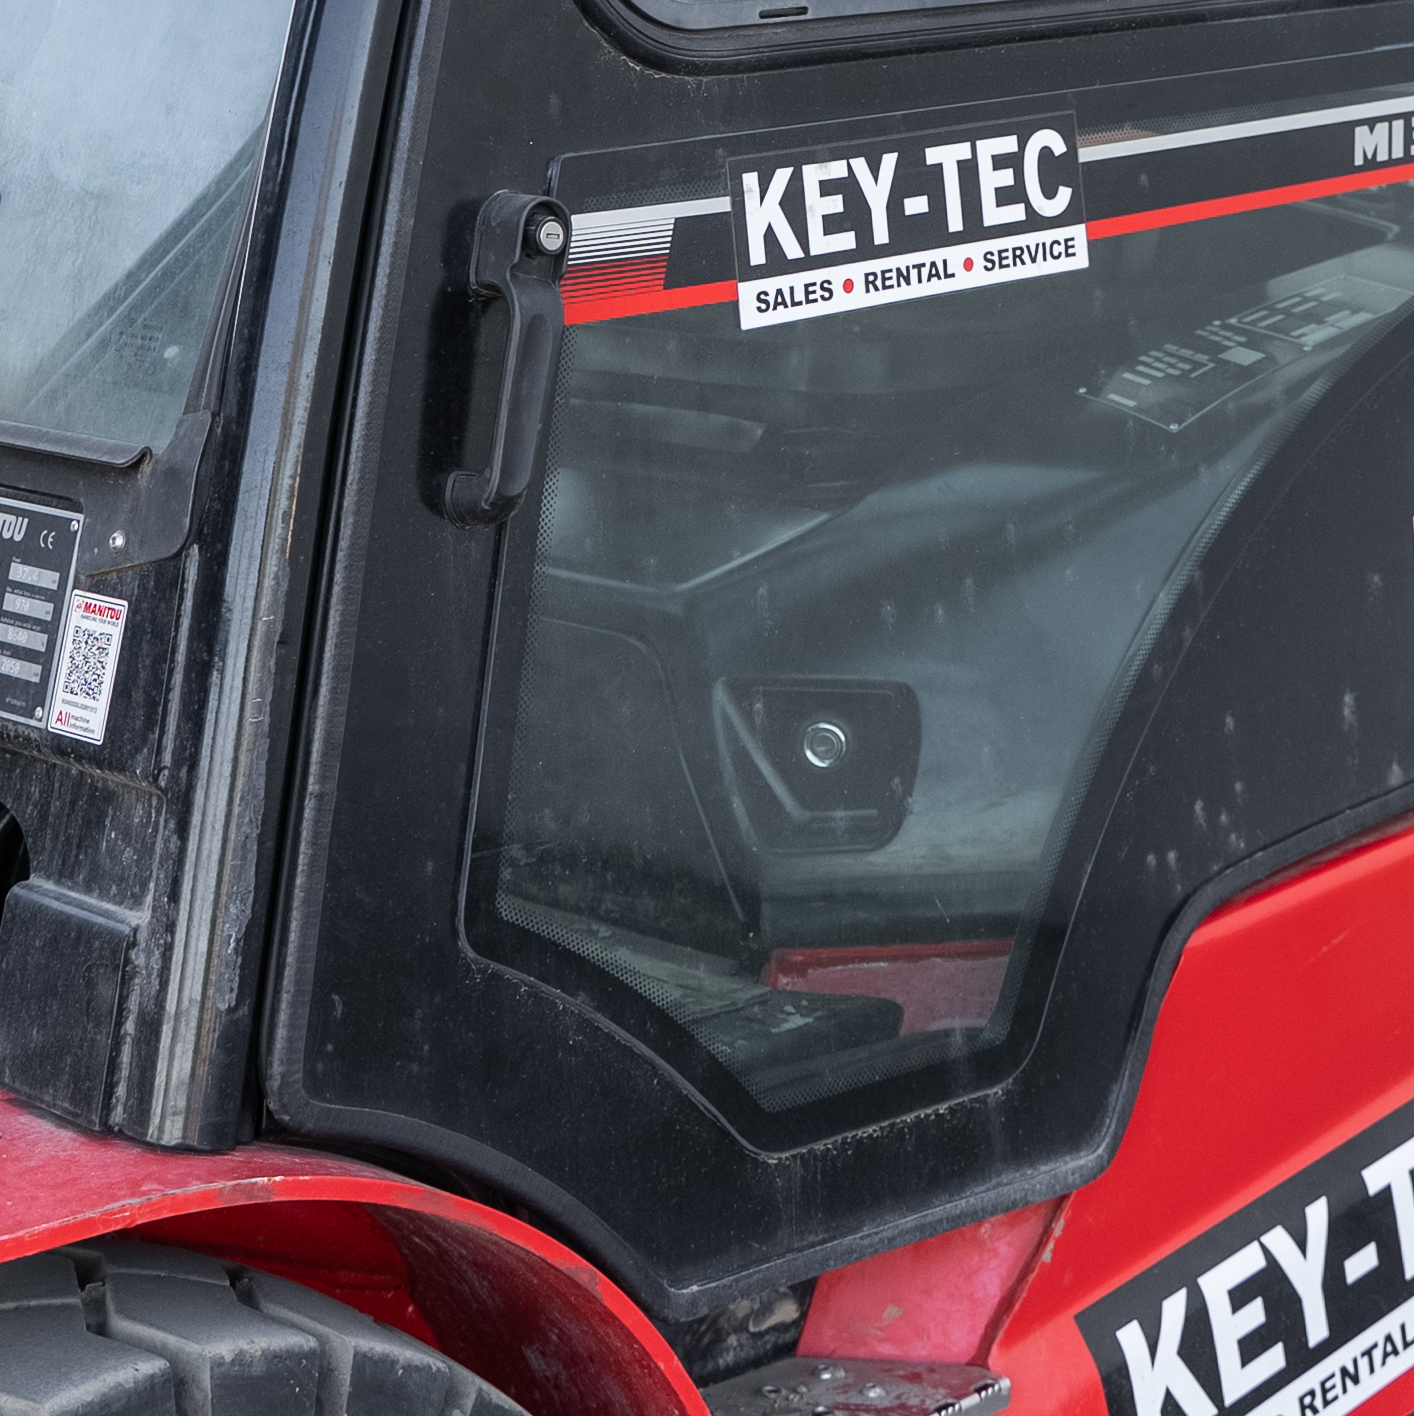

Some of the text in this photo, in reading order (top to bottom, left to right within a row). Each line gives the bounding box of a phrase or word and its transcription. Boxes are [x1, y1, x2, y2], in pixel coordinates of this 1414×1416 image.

[740, 127, 1074, 267] KEY-TEC
[755, 236, 1077, 314] SALES RENTAL SERVICE
[16, 566, 40, 583] 37.4
[83, 601, 123, 621] MANITOU
[55, 710, 71, 727] All
